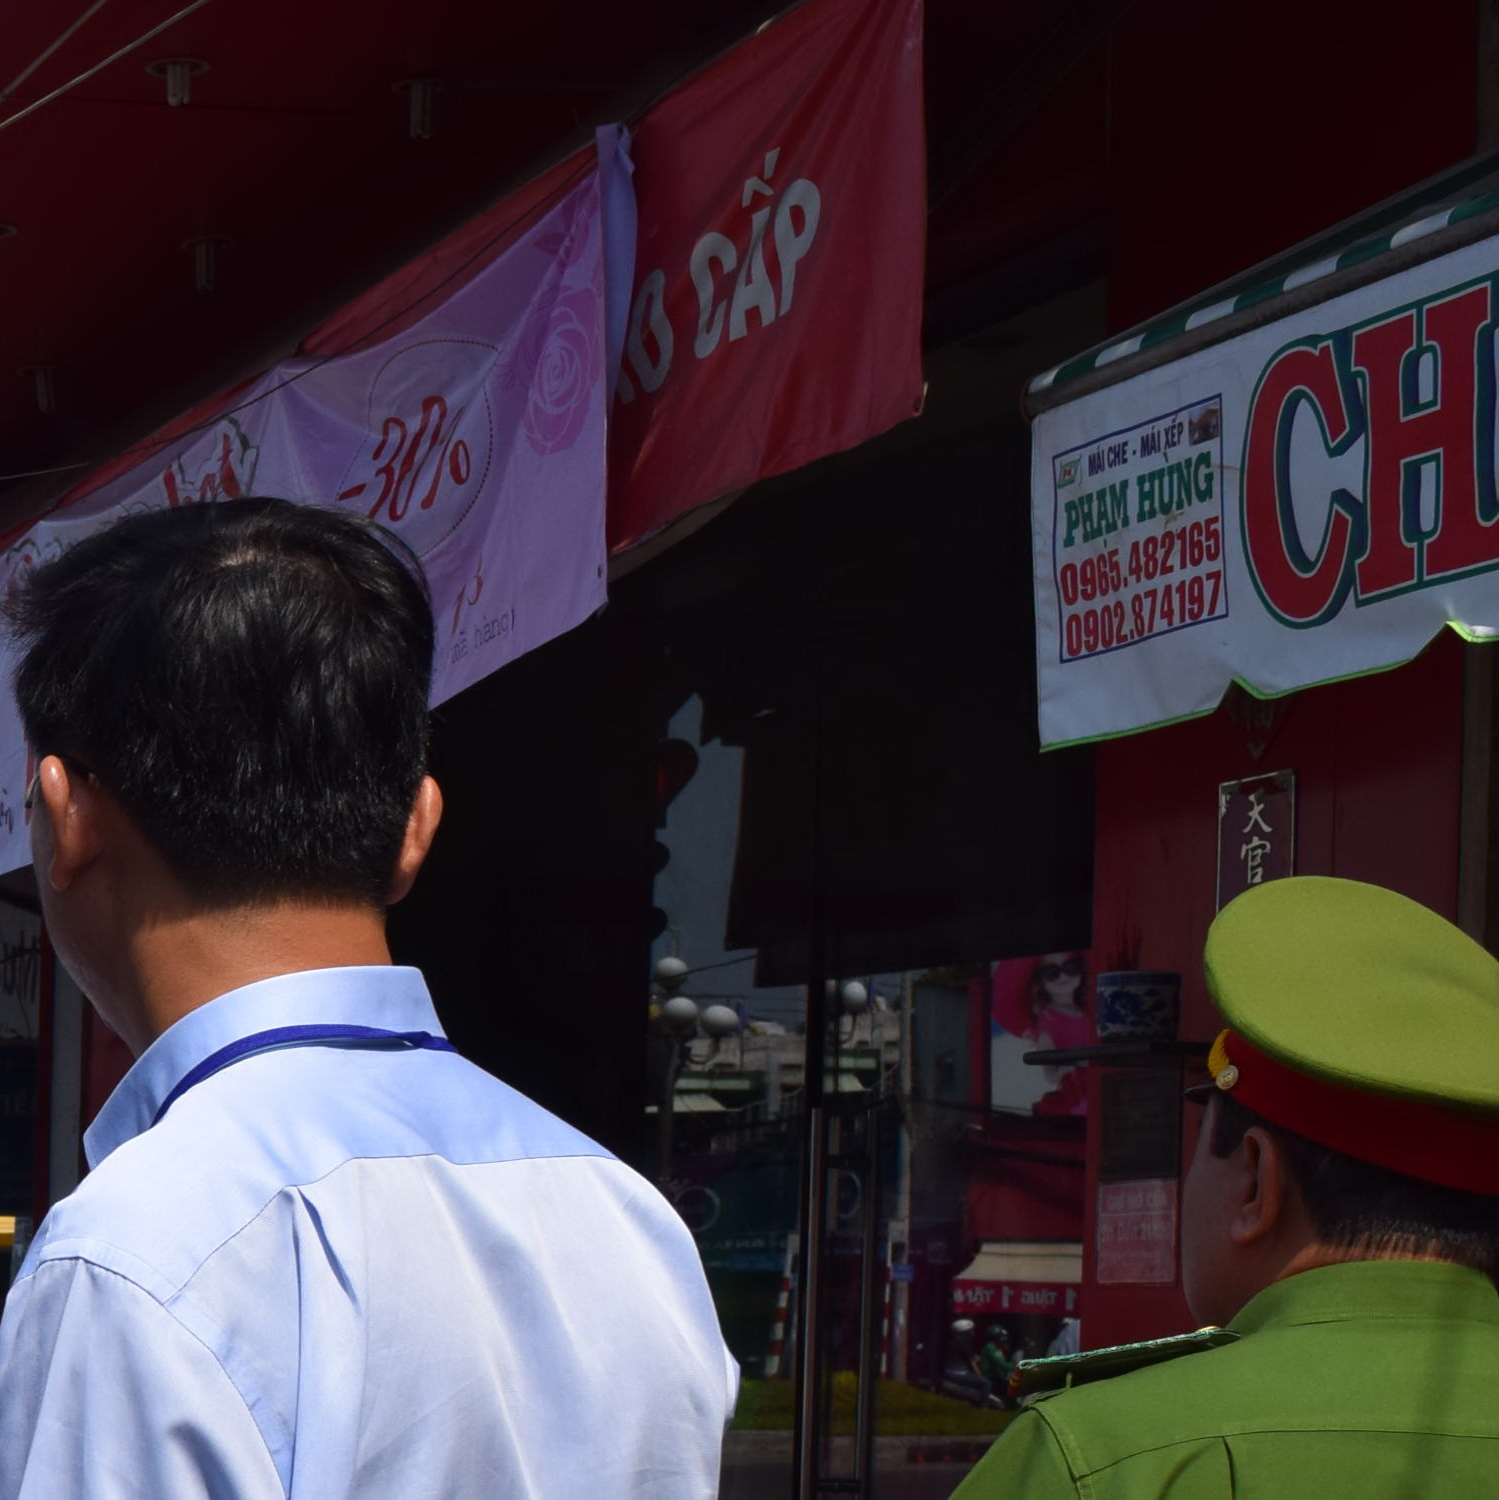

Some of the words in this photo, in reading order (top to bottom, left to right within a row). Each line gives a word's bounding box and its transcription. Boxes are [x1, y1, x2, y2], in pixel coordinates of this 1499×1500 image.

[690, 146, 821, 359] CẤP
[340, 395, 476, 524] -30%
[1088, 444, 1105, 477] MÁI
[1106, 441, 1129, 468] CHE
[1140, 425, 1161, 458] MÁI
[1163, 414, 1184, 451] XẾP
[1063, 478, 1130, 549] PHẠM
[1137, 451, 1215, 524] HÙNG
[1060, 516, 1220, 606] 0965.482165
[1066, 570, 1222, 657] 0902.874197
